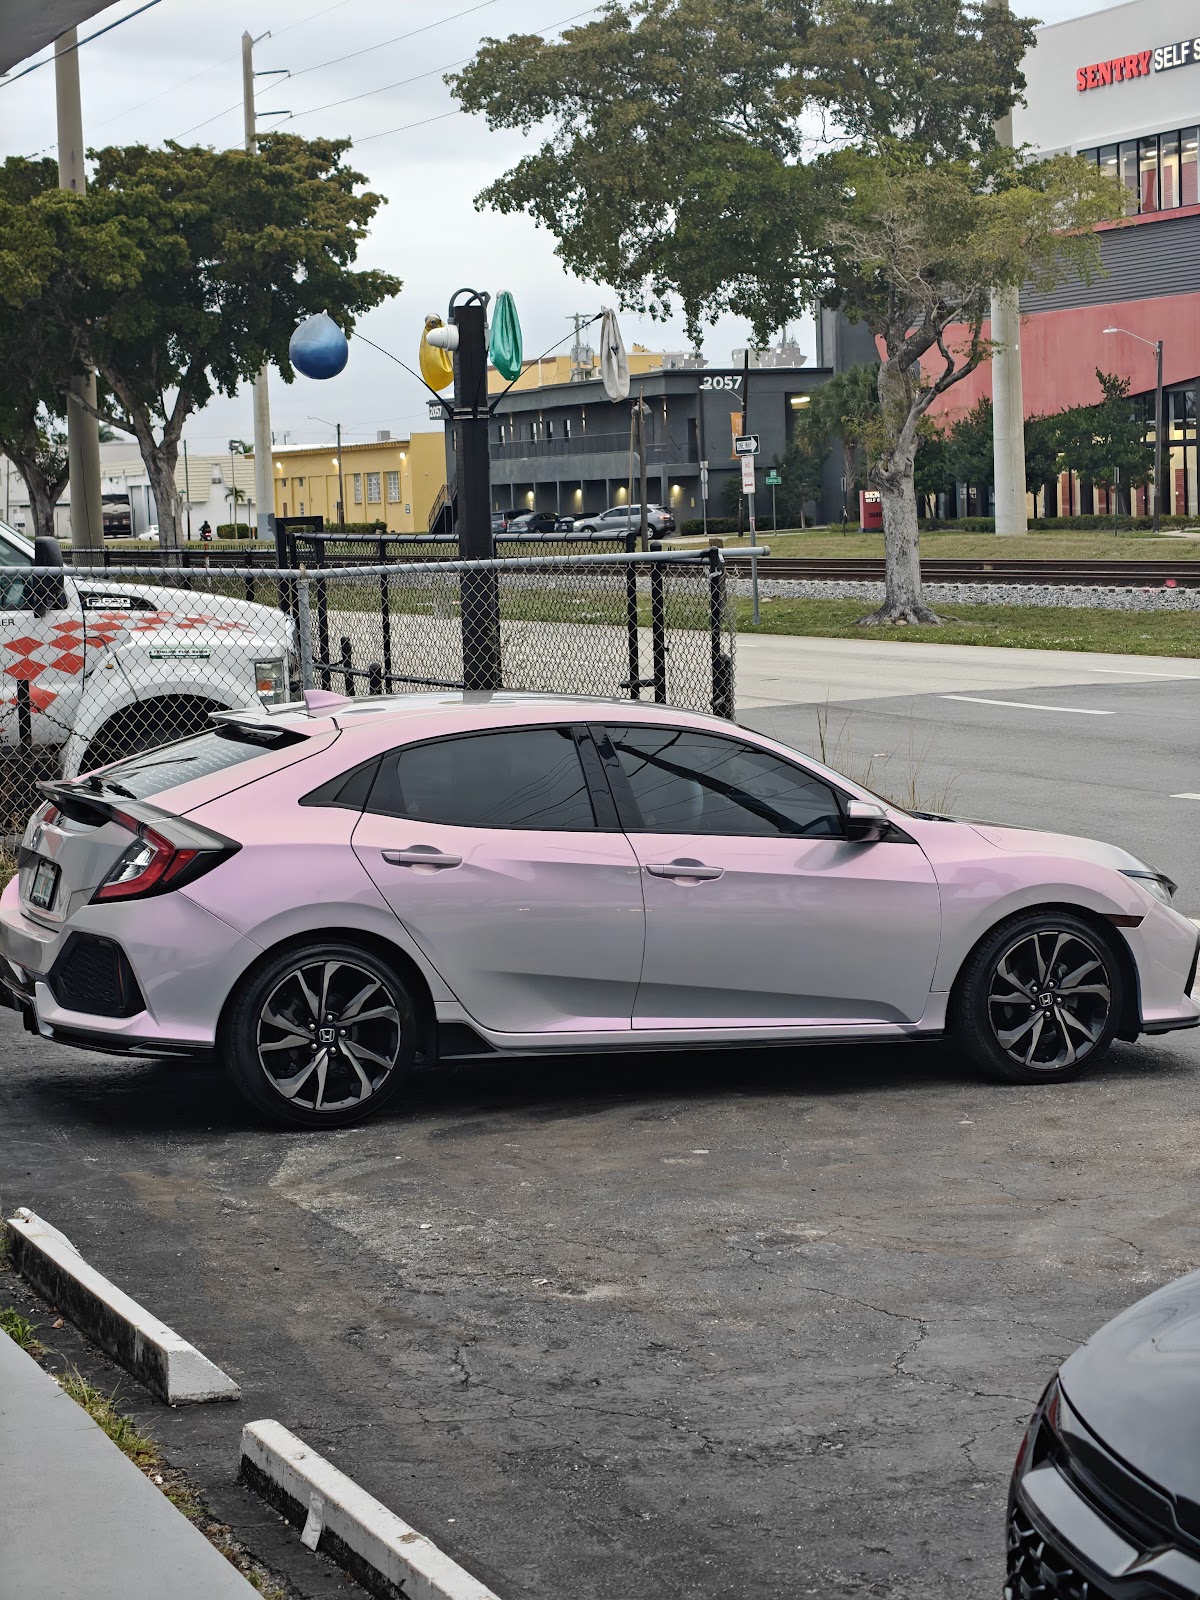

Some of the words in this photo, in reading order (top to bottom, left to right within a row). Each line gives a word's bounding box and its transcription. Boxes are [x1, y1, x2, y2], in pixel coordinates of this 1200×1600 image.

[1076, 50, 1152, 91] SENTRY
[1154, 41, 1190, 70] SELF
[703, 376, 743, 390] 2057
[430, 405, 442, 418] 2057
